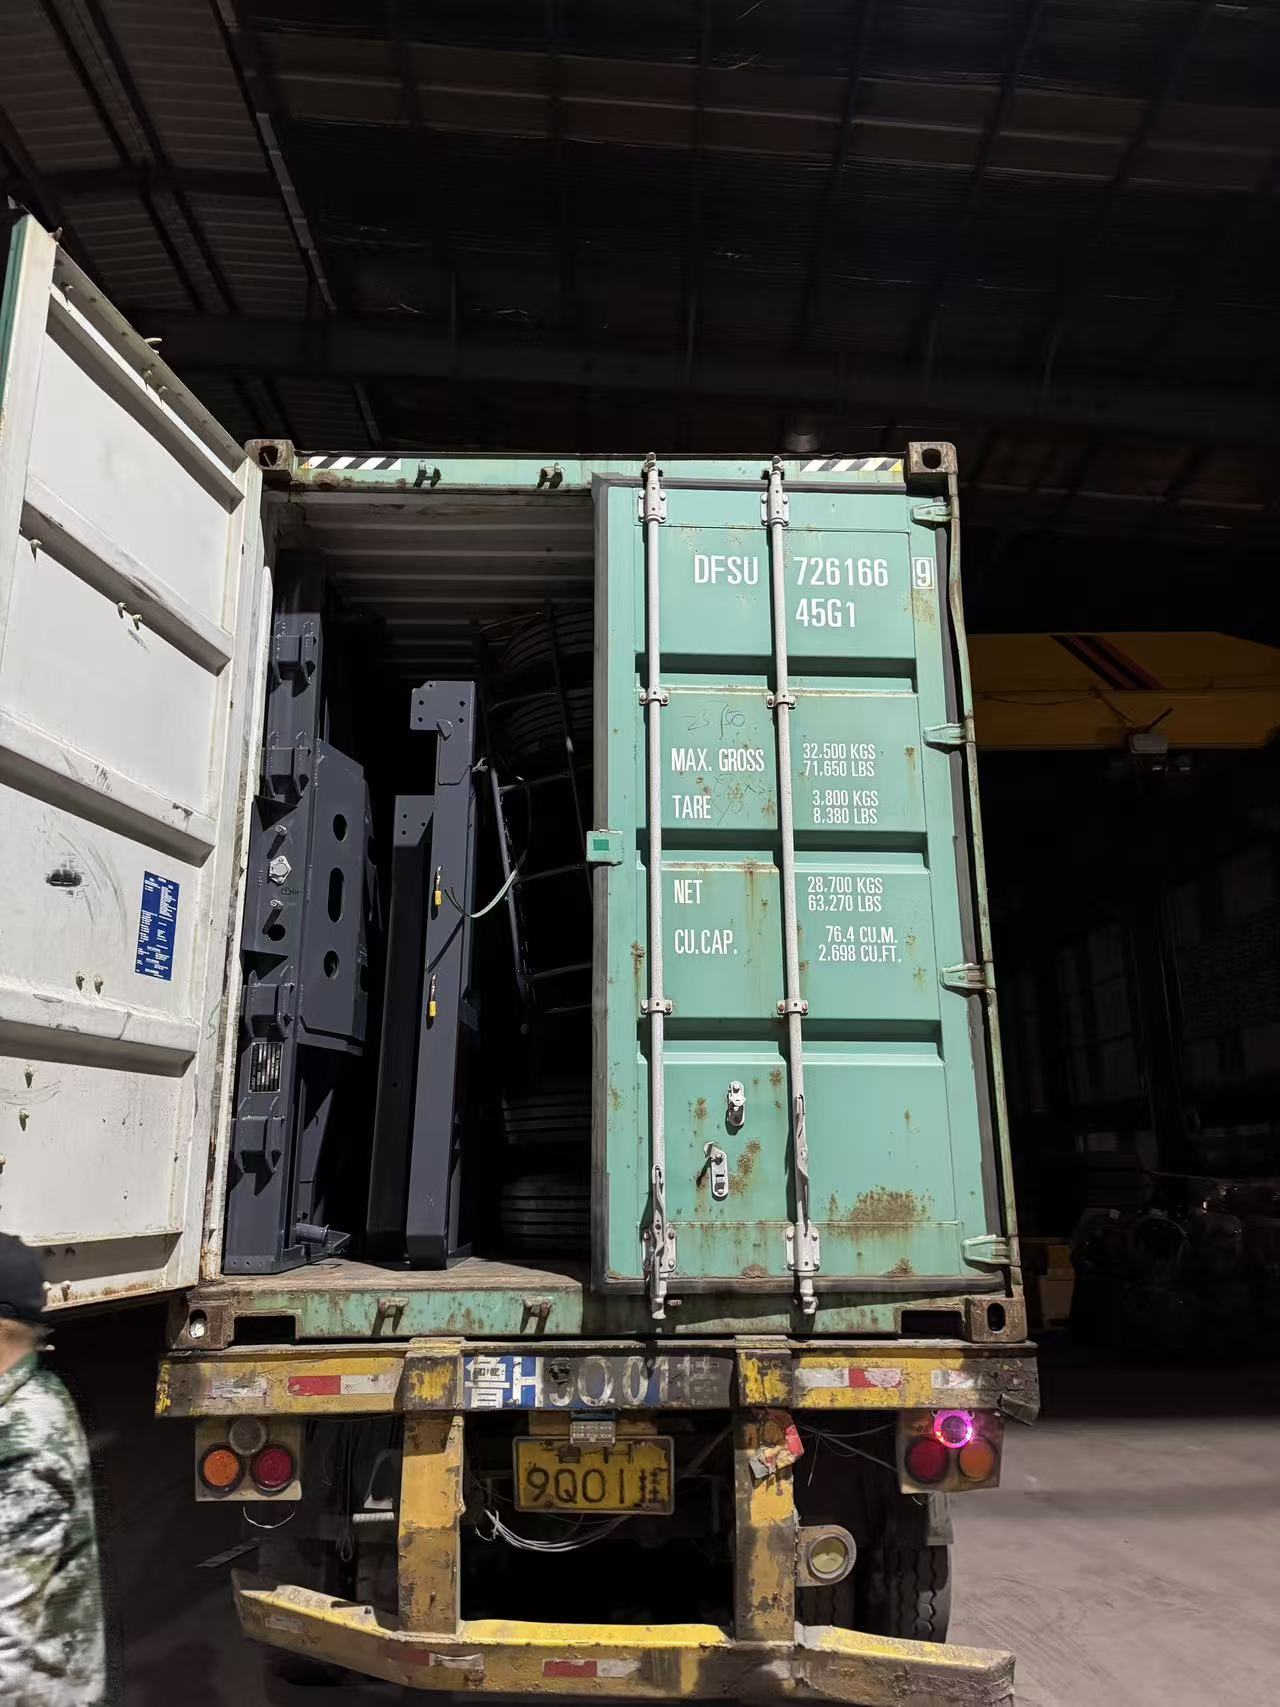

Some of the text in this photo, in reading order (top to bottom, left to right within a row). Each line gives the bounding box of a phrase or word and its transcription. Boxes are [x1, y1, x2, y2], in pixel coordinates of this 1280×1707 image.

[694, 554, 931, 587] DFSU 726166 9
[795, 598, 855, 628] 45G1
[671, 747, 765, 772] MAX. GROSS
[850, 743, 876, 760] KGS
[851, 761, 875, 777] LBS
[672, 794, 712, 819] TARE
[853, 790, 879, 807] KGS
[853, 807, 878, 824] LBS
[674, 879, 703, 904] NET
[856, 877, 883, 894] KGS
[857, 895, 882, 912] LBS
[674, 929, 738, 955] CU.CAP.
[825, 925, 898, 944] 76.4 CU.M.
[860, 944, 902, 962] CU.FT.
